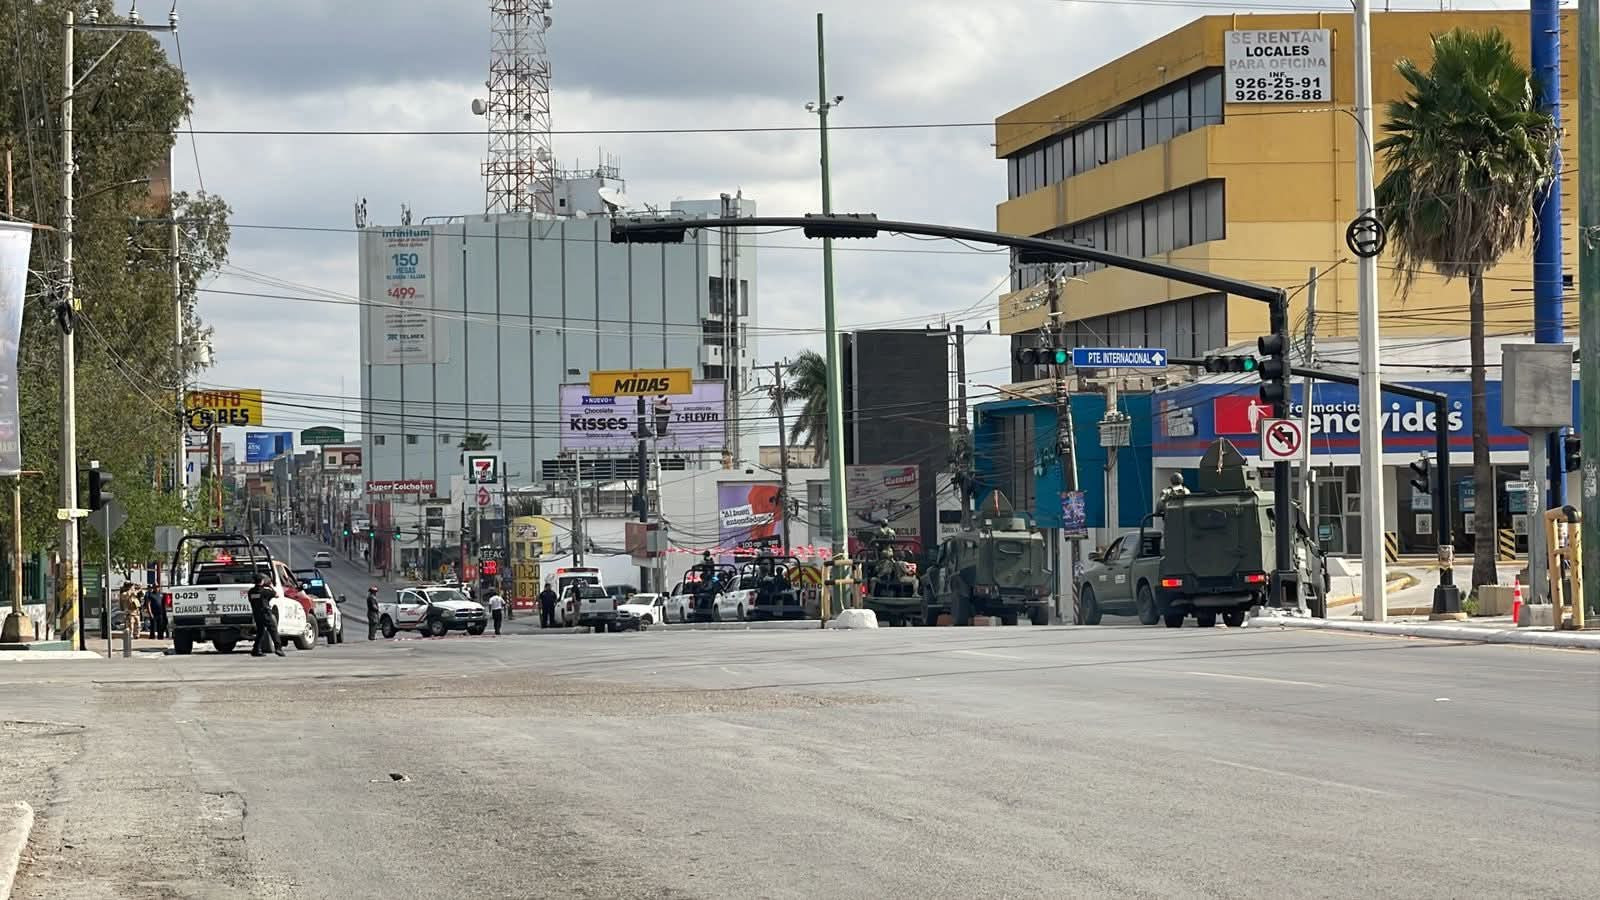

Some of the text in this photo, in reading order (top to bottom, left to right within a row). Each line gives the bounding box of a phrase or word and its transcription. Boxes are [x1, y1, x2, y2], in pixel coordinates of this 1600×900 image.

[1232, 31, 1323, 43] SE RENTAN
[1246, 45, 1309, 57] LOCALES
[1229, 57, 1327, 69] PARA OFICINA
[1235, 77, 1321, 89] 926-25-91
[392, 253, 418, 266] 150
[388, 287, 416, 299] $499
[1088, 352, 1152, 364] PTE. INTERNACIONAL
[614, 377, 669, 393] MIDAS
[175, 604, 251, 614] GUARDIA ESTATAL
